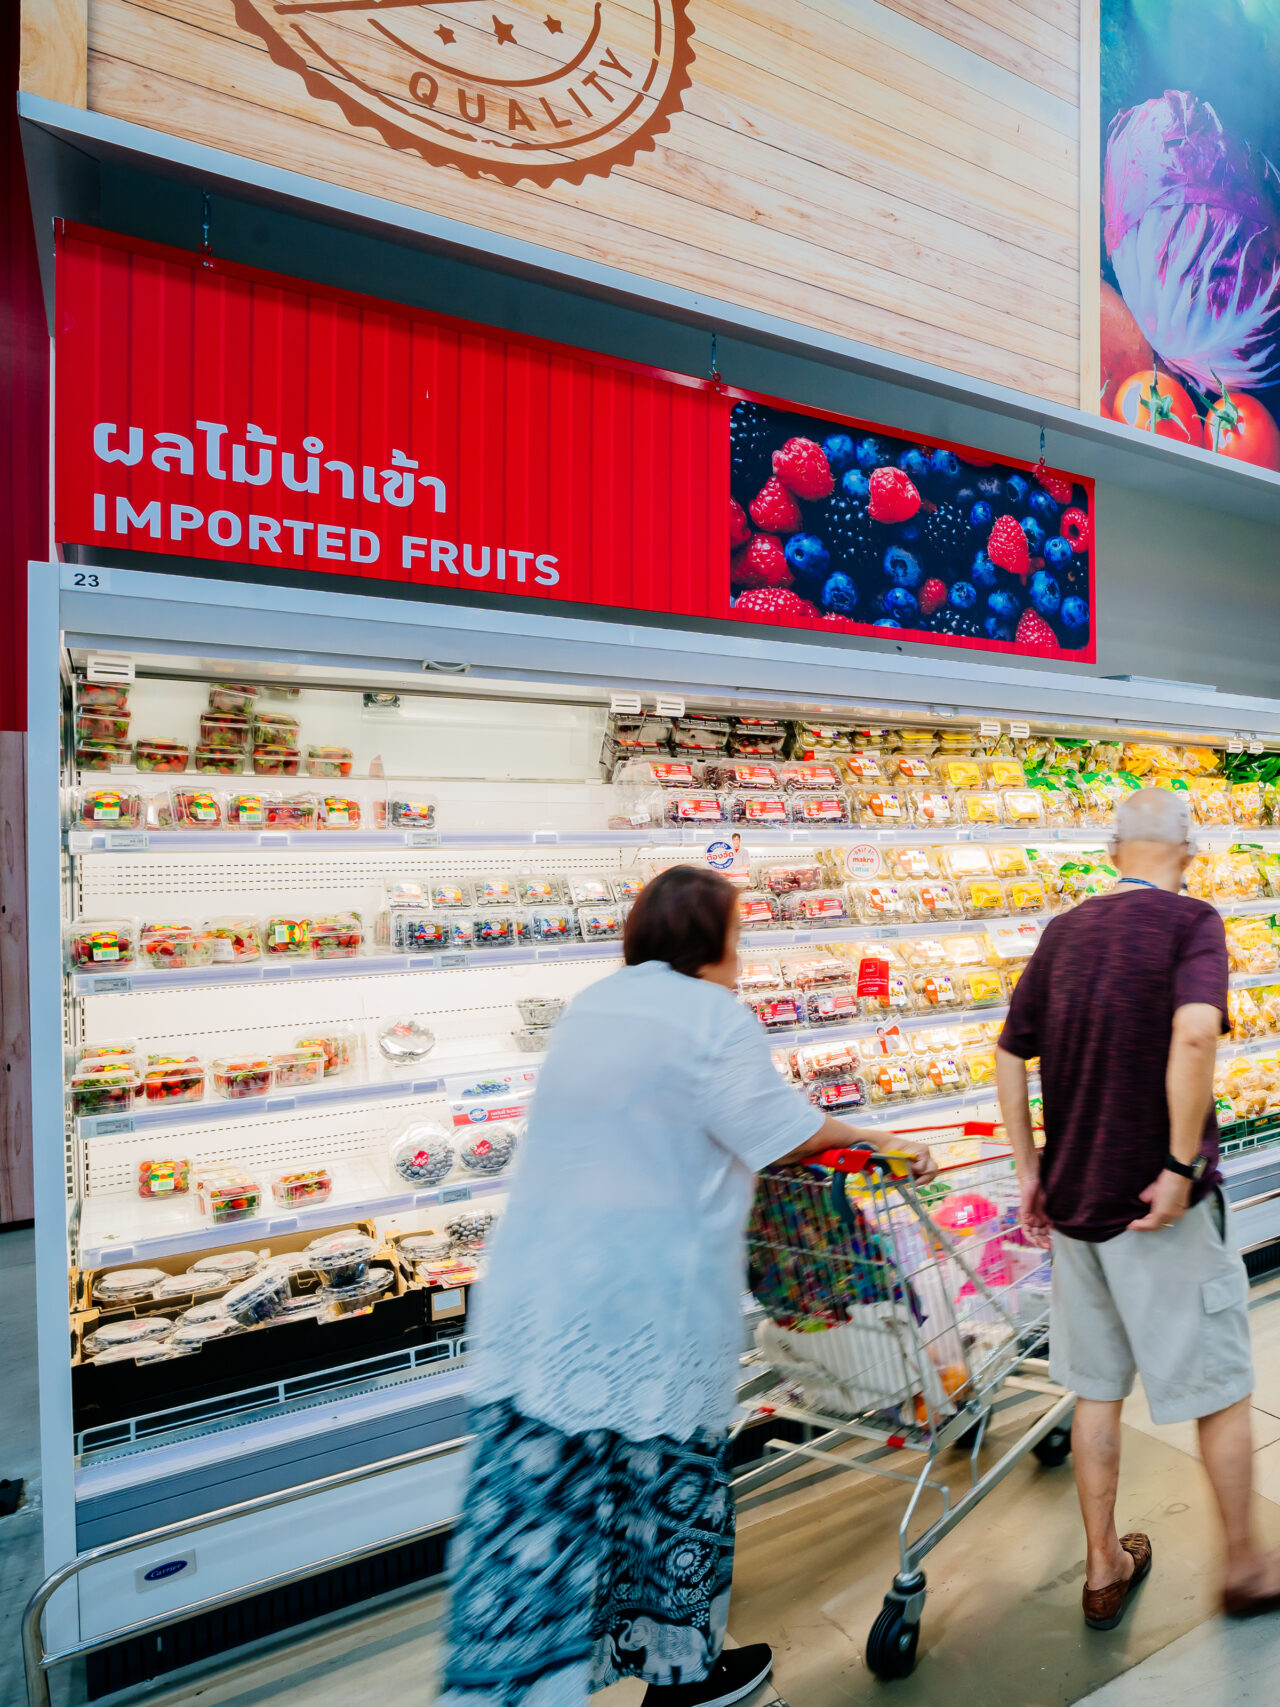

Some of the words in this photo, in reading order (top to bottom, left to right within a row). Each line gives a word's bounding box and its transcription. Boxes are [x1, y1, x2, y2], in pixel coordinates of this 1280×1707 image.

[408, 47, 633, 132] QUALITY
[92, 419, 447, 513] ผลไม้นำเข้า
[73, 572, 101, 588] 23
[93, 493, 381, 564] IMPORTED
[401, 535, 561, 586] FRUITS
[150, 1563, 183, 1578] Carrier
